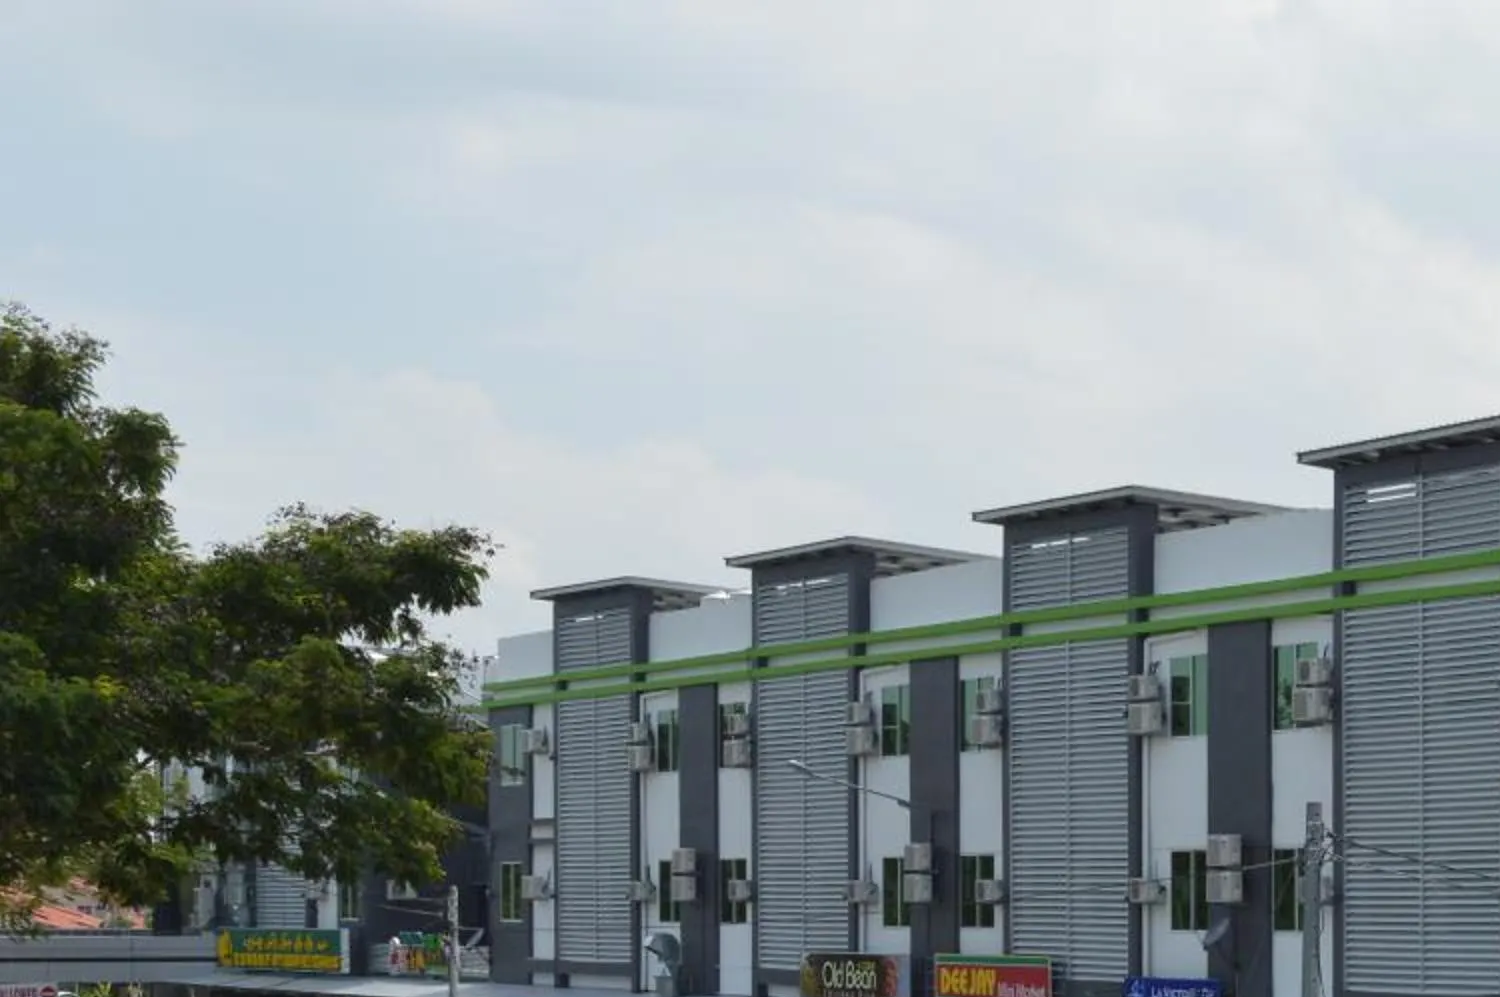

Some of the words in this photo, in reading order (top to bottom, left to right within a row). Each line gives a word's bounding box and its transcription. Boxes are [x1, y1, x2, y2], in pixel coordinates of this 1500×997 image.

[821, 960, 844, 989] Old
[845, 960, 878, 991] Bean
[939, 966, 997, 996] DEEJAY
